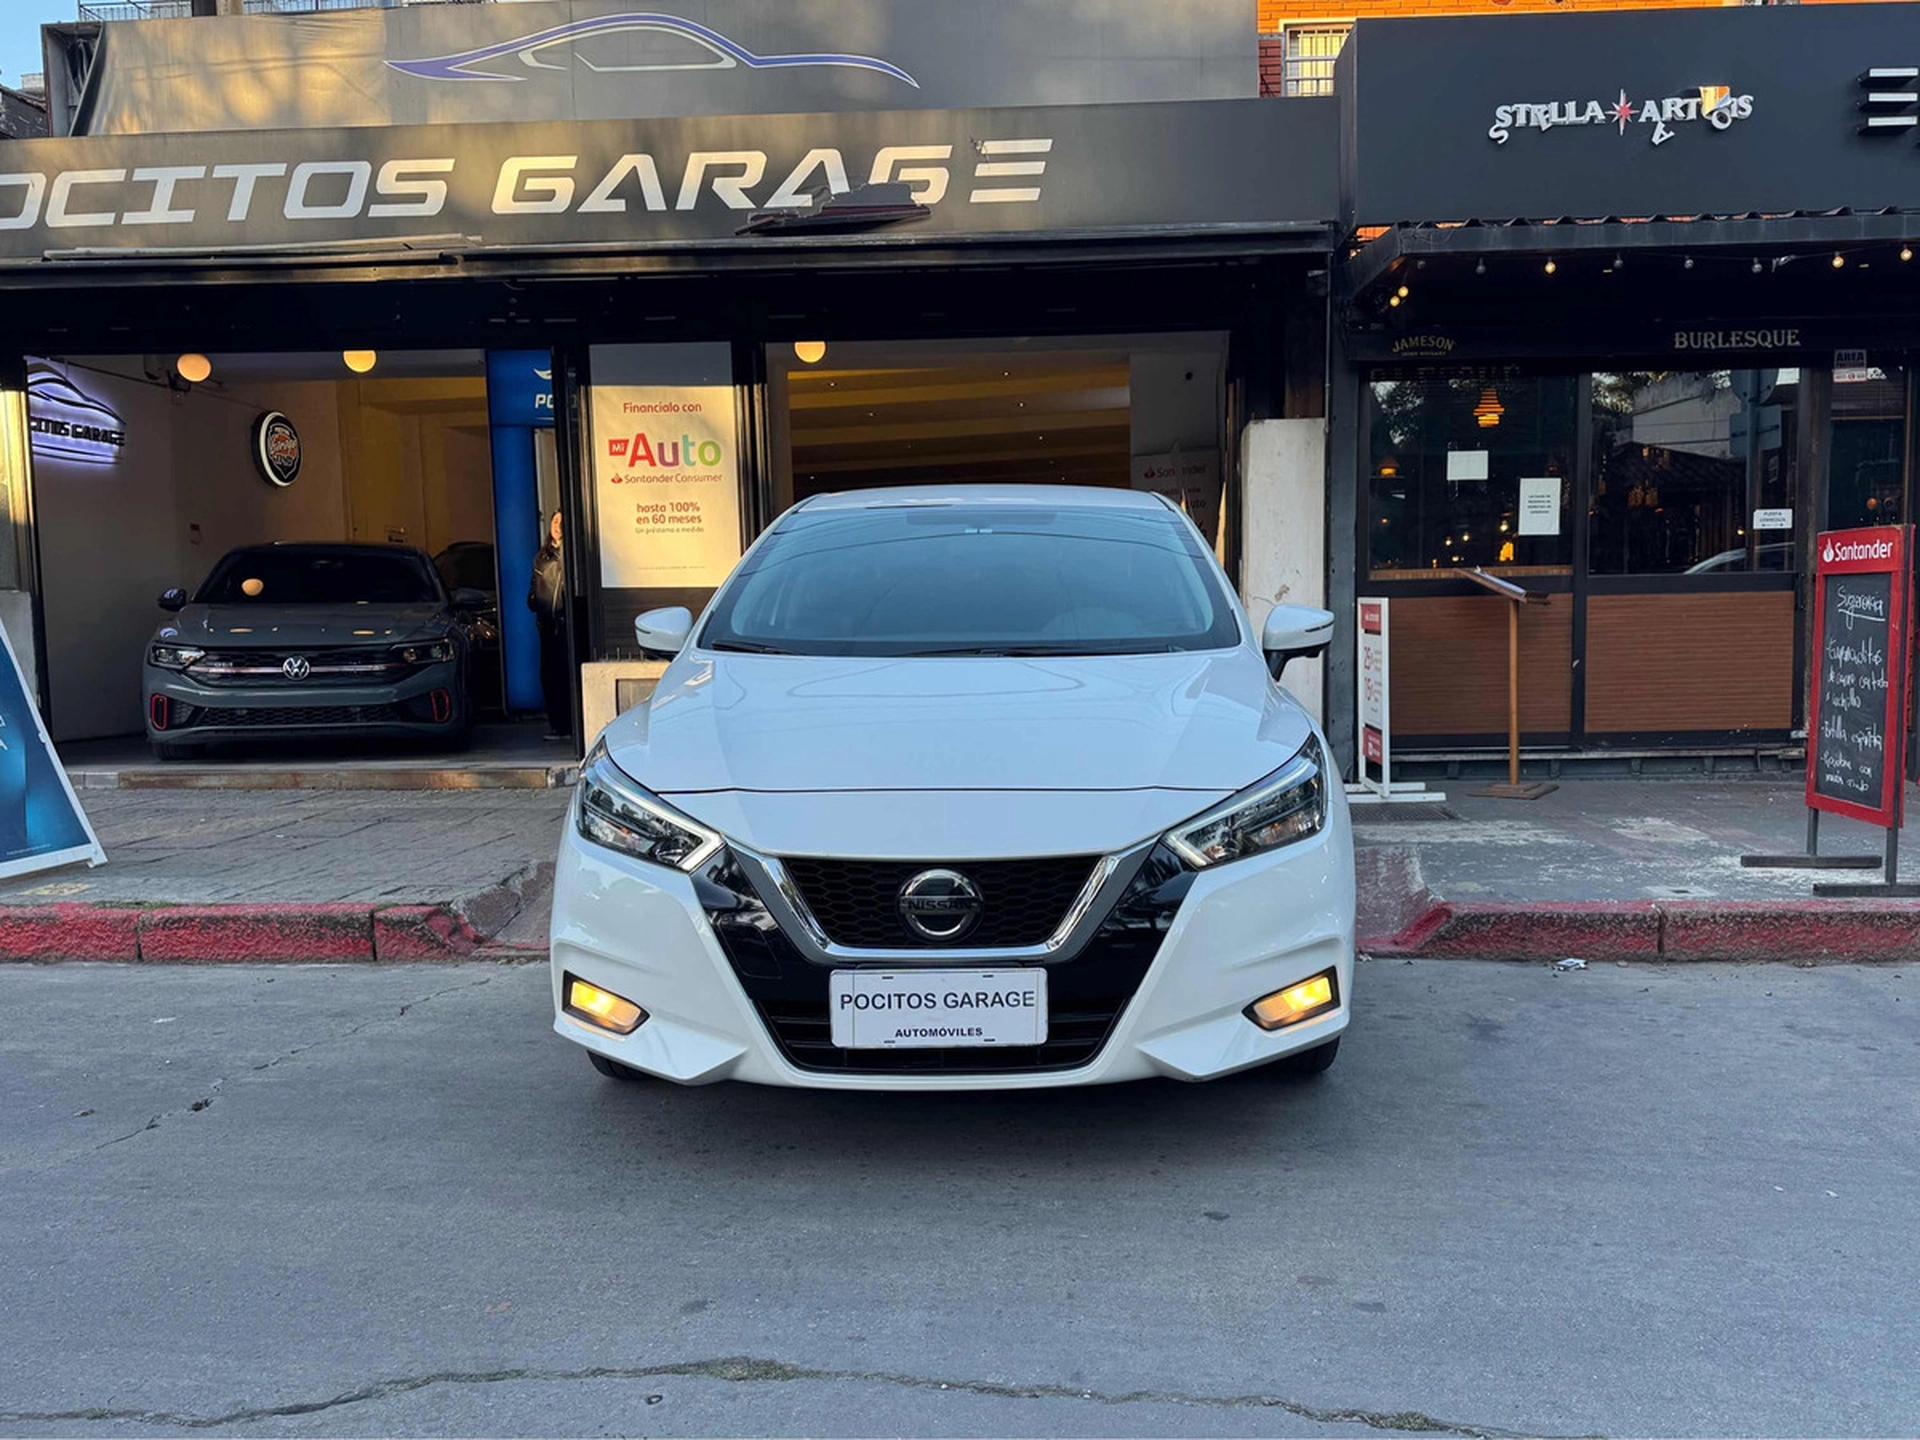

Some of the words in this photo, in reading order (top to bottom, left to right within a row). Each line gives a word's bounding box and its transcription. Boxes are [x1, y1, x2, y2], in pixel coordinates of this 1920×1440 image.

[491, 138, 1053, 215] GARAGE
[1391, 335, 1455, 352] JAMESON
[1674, 329, 1801, 349] BURLESQUE
[682, 403, 702, 412] con
[628, 433, 722, 467] Auto
[624, 473, 674, 484] Santander
[675, 473, 723, 483] Consumer
[636, 502, 666, 513] hasta
[670, 501, 700, 512] 100%
[636, 515, 650, 524] en
[652, 514, 666, 524] 60
[668, 515, 702, 524] meses
[1834, 539, 1893, 562] Santander
[907, 899, 975, 912] NISSAN
[840, 992, 937, 1010] POCITOS
[943, 990, 1035, 1009] GARAGE
[894, 1026, 983, 1038] AUTOMÓVILES
